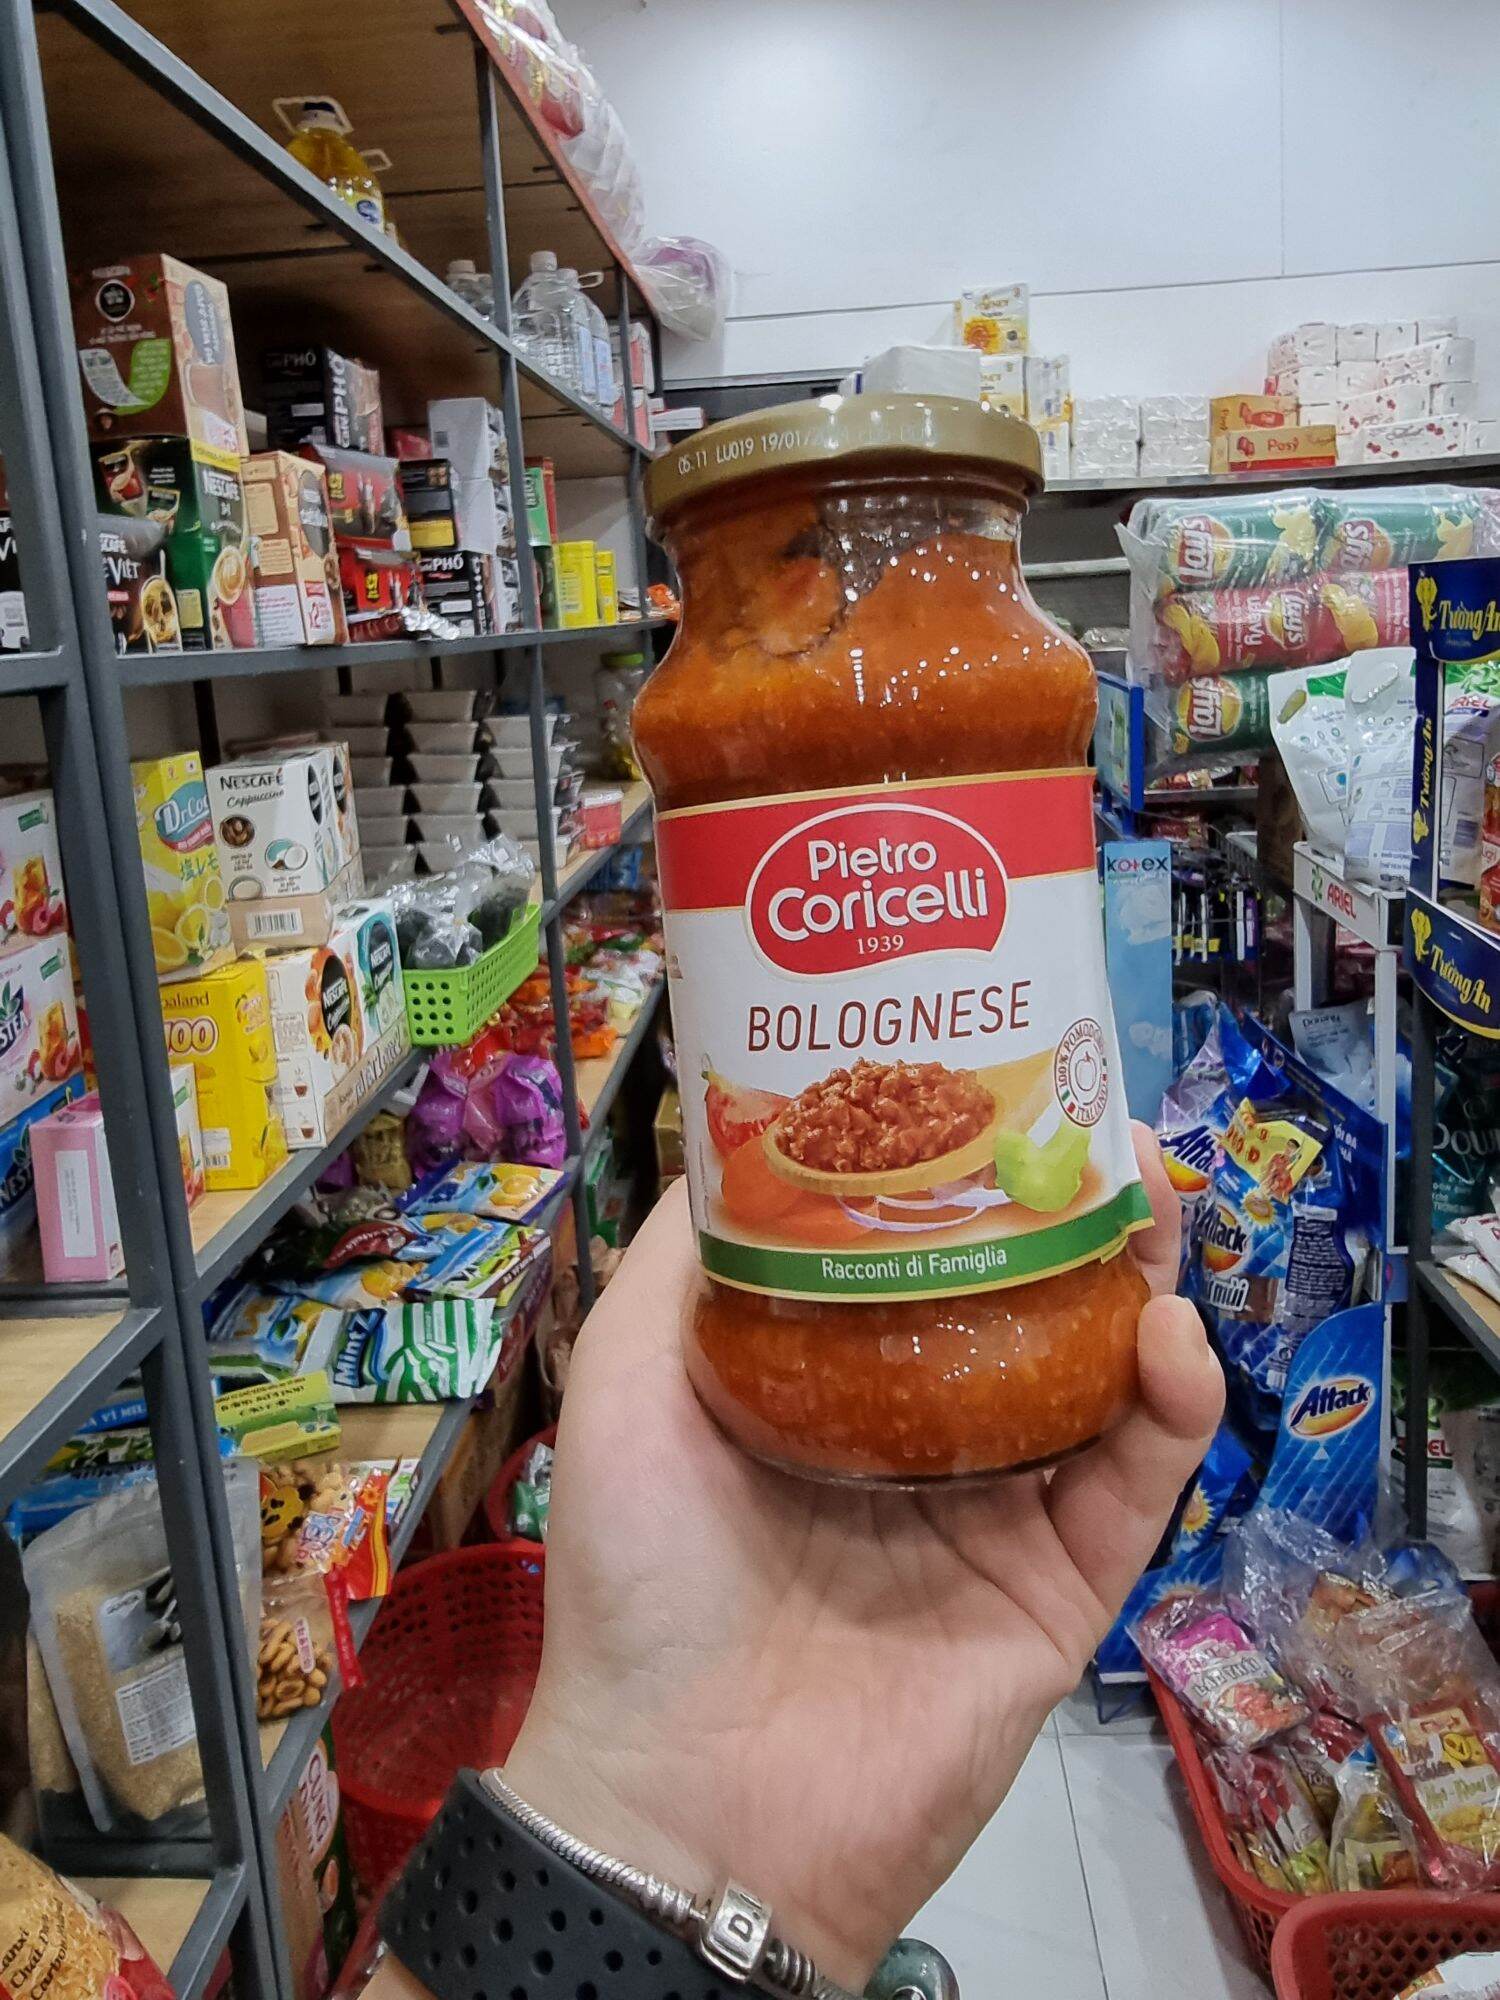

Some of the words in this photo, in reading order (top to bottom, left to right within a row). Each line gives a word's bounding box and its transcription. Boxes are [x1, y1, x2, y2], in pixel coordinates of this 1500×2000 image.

[807, 837, 938, 882] Pietro
[768, 867, 989, 941] Coricelli
[1327, 882, 1356, 919] ARIEL
[857, 934, 904, 955] 1939
[747, 980, 1031, 1052] BOLOGNESE
[822, 1256, 900, 1279] Racconti
[906, 1254, 924, 1277] di
[929, 1246, 1007, 1278] Famiglia
[1290, 1381, 1371, 1427] Attack
